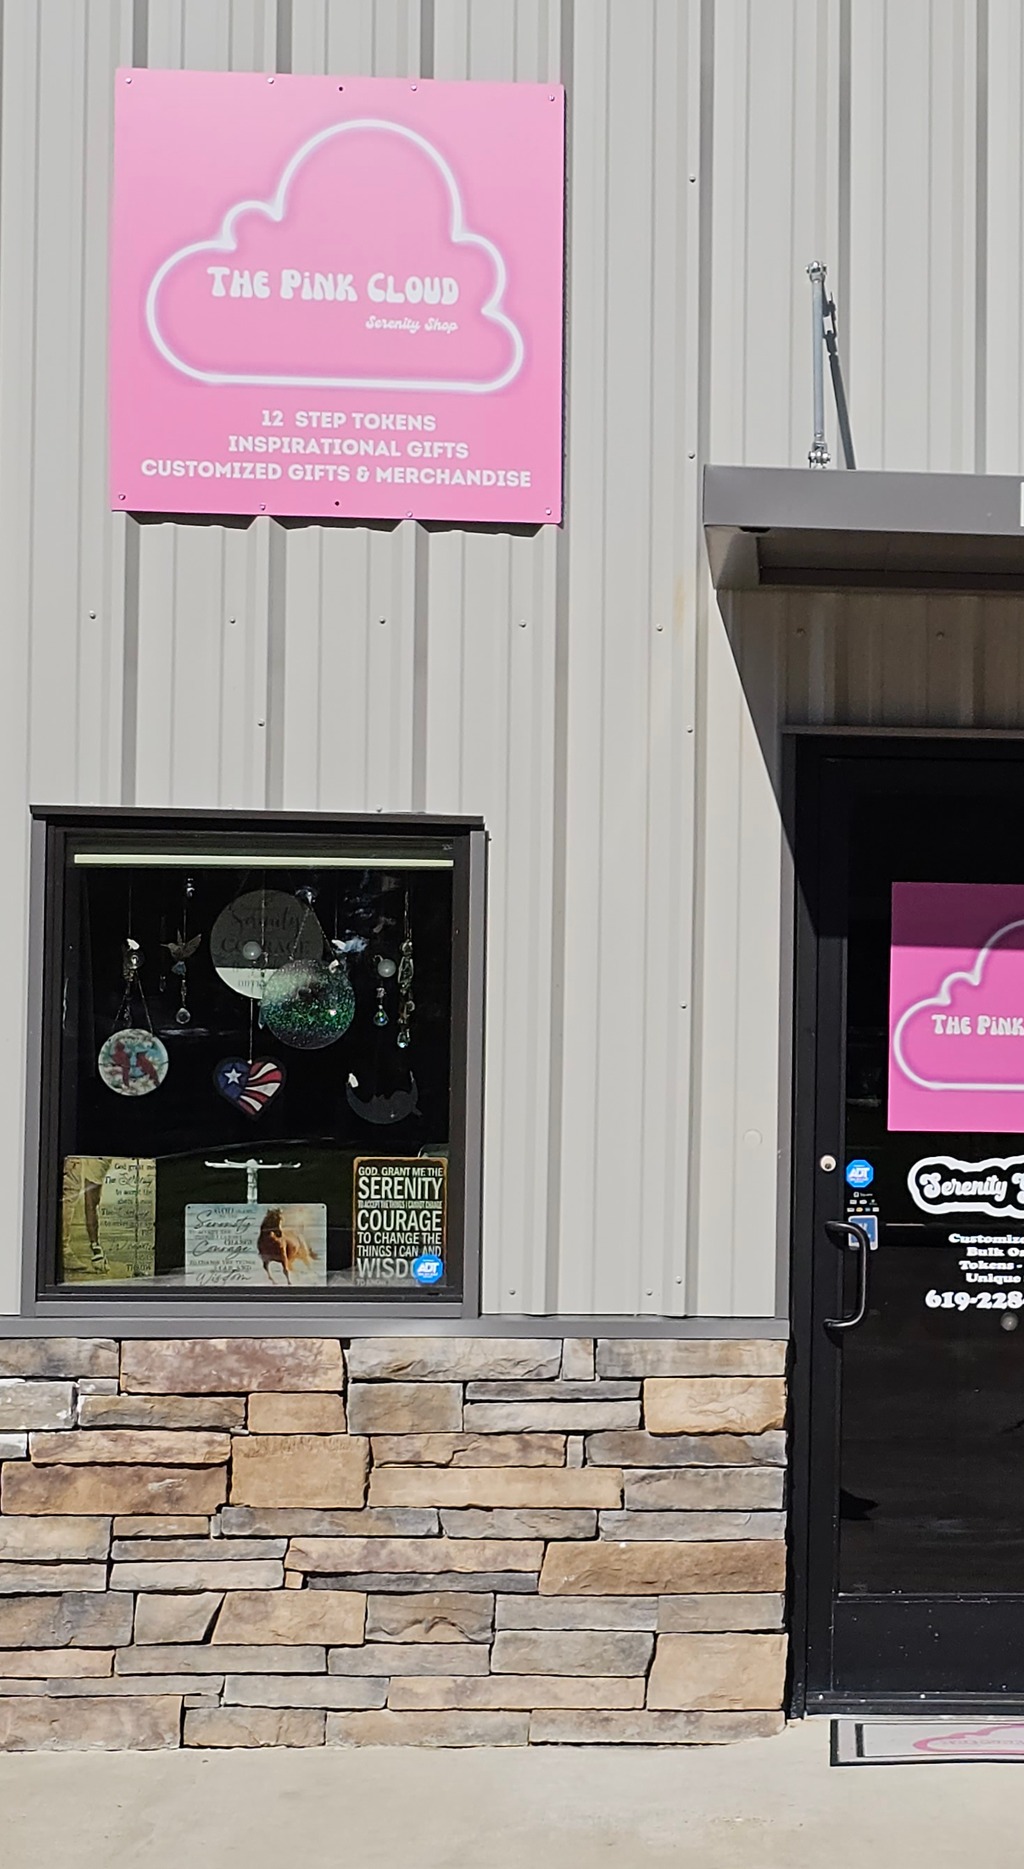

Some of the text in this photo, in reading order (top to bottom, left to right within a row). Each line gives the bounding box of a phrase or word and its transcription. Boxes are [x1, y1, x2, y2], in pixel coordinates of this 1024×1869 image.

[207, 266, 270, 299] THE
[367, 272, 459, 305] CLOUD
[365, 315, 459, 334] Serenity Shop
[261, 409, 436, 431] 12 STEP TOKENS
[228, 435, 469, 460] INSPIRATIONAL GIFTS
[141, 459, 531, 488] CUSTOMIZED GIFTS & MERCHANDISE
[931, 1013, 971, 1035] THE
[381, 1166, 411, 1177] GRANT
[412, 1167, 426, 1177] ME
[427, 1167, 443, 1177] THE
[849, 1167, 871, 1178] ADT
[357, 1177, 443, 1200] SERENITY
[919, 1172, 1008, 1202] Serenity
[357, 1209, 442, 1232] COURAGE
[357, 1231, 442, 1245] TO CHANGE THE
[356, 1245, 392, 1257] THINGS
[399, 1245, 418, 1258] CAN
[422, 1245, 442, 1257] AND
[966, 1246, 1005, 1257] Bulk
[356, 1258, 418, 1279] WISD
[417, 1262, 440, 1273] ADT
[958, 1260, 1015, 1271] Tokens
[965, 1273, 1021, 1285] Unique
